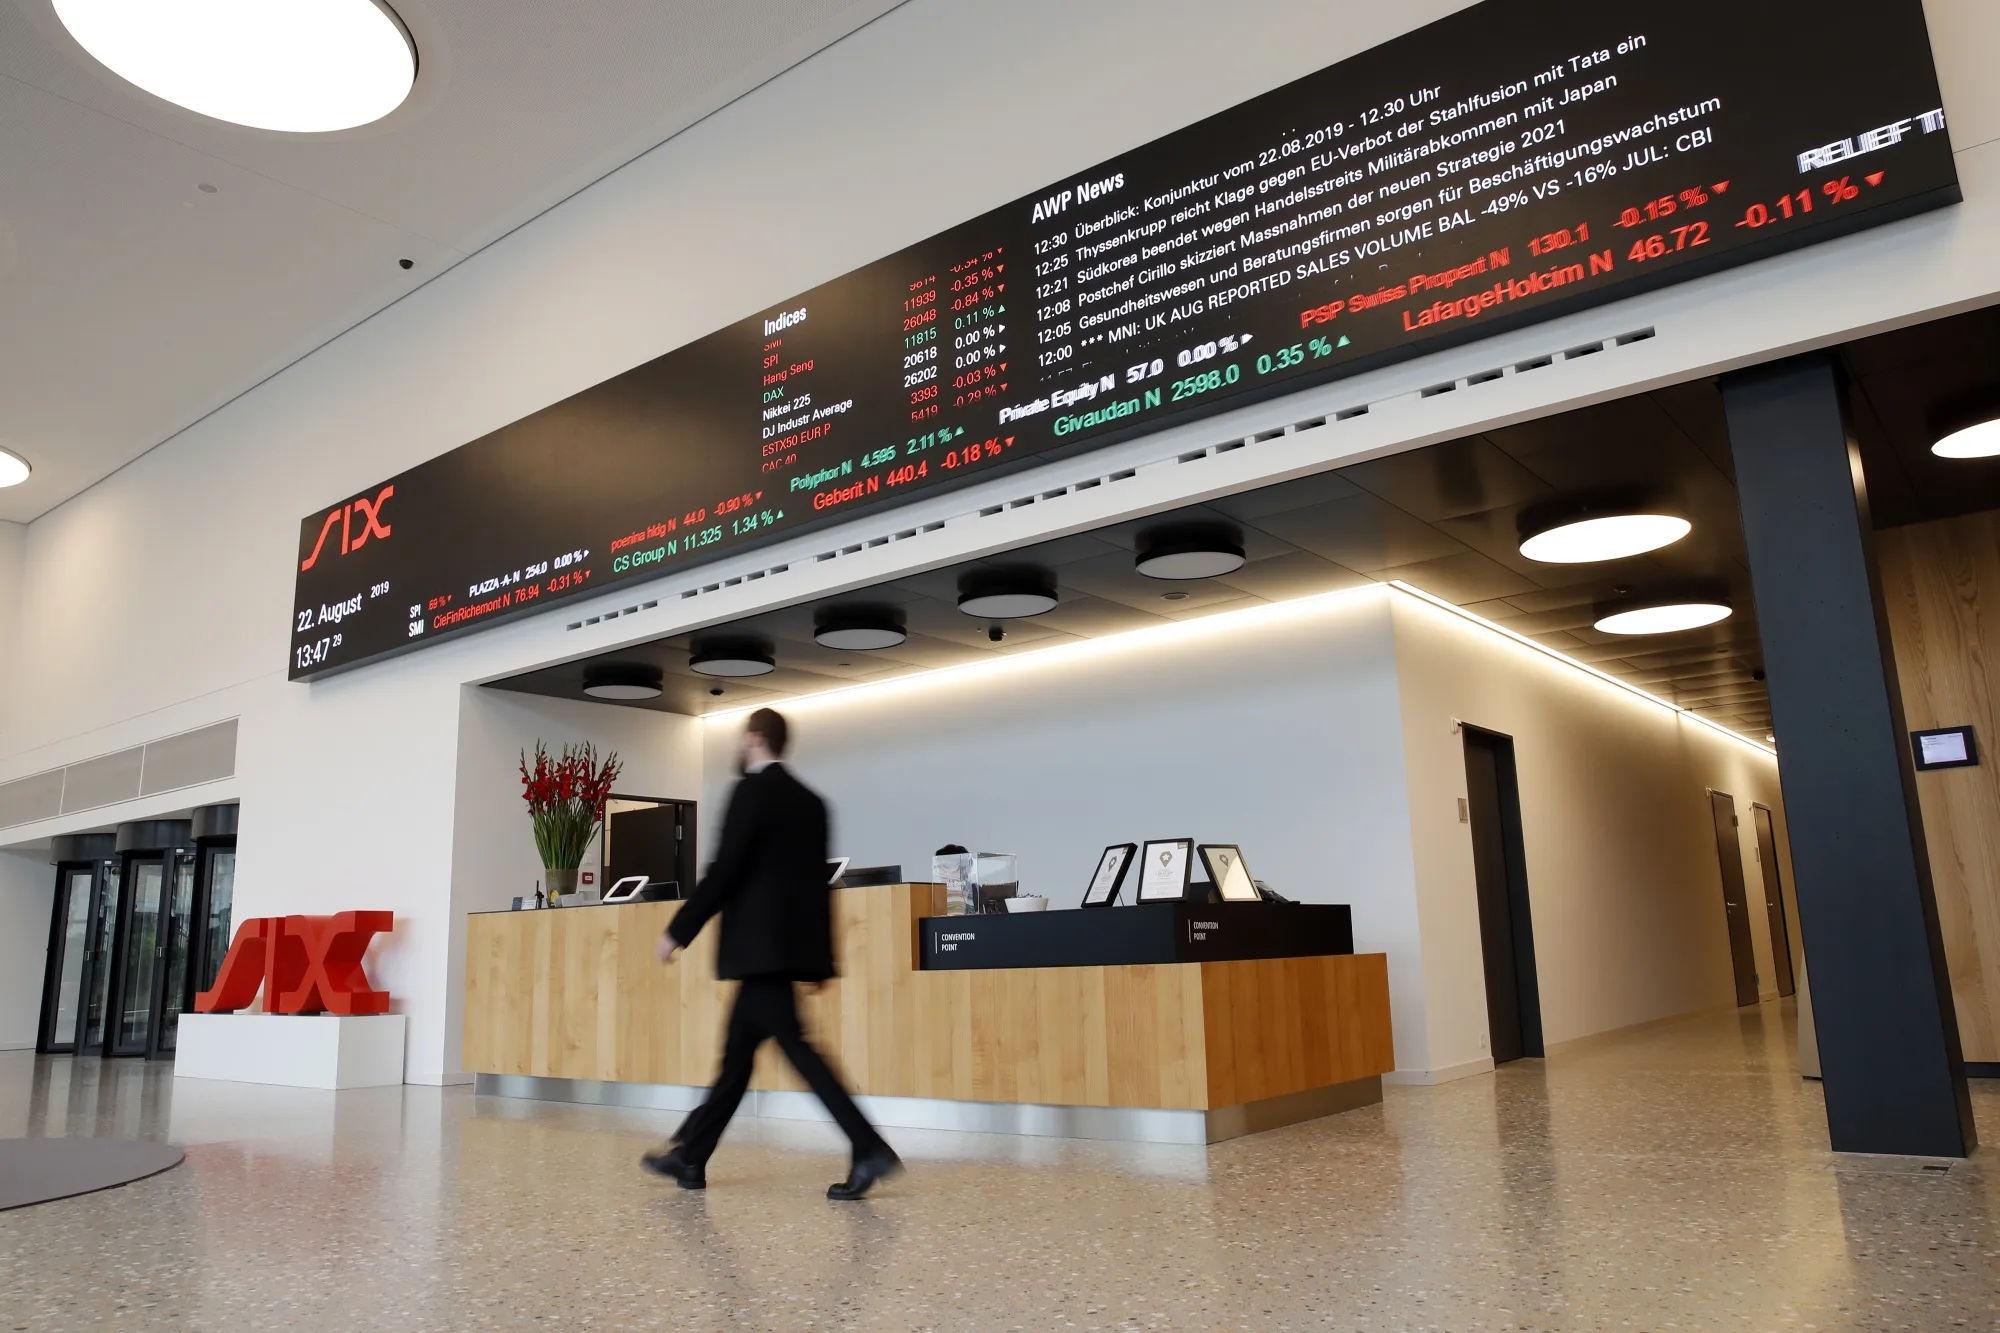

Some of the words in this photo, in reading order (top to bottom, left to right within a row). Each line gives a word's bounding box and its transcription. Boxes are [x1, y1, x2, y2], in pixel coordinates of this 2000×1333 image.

[1034, 231, 1068, 255] 12:30
[1075, 205, 1140, 239] Überblick:
[1144, 173, 1219, 212] Konjunktur
[1222, 160, 1255, 180] vom
[1258, 122, 1344, 167] 22.08.2019
[1360, 98, 1405, 126] 12.30
[1409, 86, 1441, 107] Uhr
[1035, 253, 1069, 277] 12:25
[1075, 218, 1167, 261] Thyssenkrupp
[1171, 200, 1211, 225] reicht
[1214, 185, 1255, 209] Klage
[1259, 165, 1306, 194] gegen
[1310, 130, 1393, 172] EU-Verbot
[1397, 119, 1425, 138] der
[1429, 80, 1528, 126] Stahlfusion
[1533, 64, 1565, 87] mit
[1567, 49, 1611, 73] Tata
[1616, 35, 1646, 55] ein
[1036, 276, 1068, 299] 12:21
[1077, 253, 1138, 284] Südkorea
[1141, 229, 1198, 260] beendet
[1200, 211, 1250, 237] wegen
[1254, 169, 1363, 218] Handelsstreits
[1368, 112, 1518, 176] Militärabkommen
[1523, 96, 1555, 119] mit
[1559, 75, 1617, 106] Japan
[1797, 118, 1912, 174] RELIEF
[1031, 190, 1072, 224] AWP
[1077, 173, 1125, 205] News
[1036, 298, 1071, 322] 12:08
[1078, 274, 1135, 307] Postchef
[1138, 262, 1176, 285] Cirillo
[1179, 239, 1236, 270] skizziert
[1240, 203, 1342, 249] Massnahmen
[1347, 190, 1374, 209] der
[1379, 171, 1431, 199] neuen
[1436, 140, 1516, 178] Strategie
[1520, 119, 1565, 149] 2021
[1037, 321, 1072, 344] 12:05
[1078, 277, 1205, 329] Gesundheitswesen
[1209, 262, 1238, 284] und
[1242, 219, 1371, 273] Beratungsfirmen
[1376, 198, 1433, 226] sorgen
[1438, 186, 1463, 205] für
[1469, 97, 1721, 194] Beschäftigungswachstum
[1038, 344, 1073, 367] 12:00
[1108, 322, 1141, 344] MNI:
[1145, 311, 1167, 331] UK
[1170, 299, 1204, 323] AUG
[1208, 270, 1291, 310] REPORTED
[1296, 249, 1350, 280] SALES
[1354, 221, 1433, 260] VOLUME
[1438, 209, 1476, 233] BAL
[1481, 189, 1528, 215] -49%
[1532, 179, 1560, 200] VS
[1566, 159, 1617, 187] -16%
[1622, 145, 1669, 171] JUL:
[1675, 126, 1712, 152] CBI
[1300, 299, 1345, 329] PSP
[1348, 284, 1408, 313] Swiss
[1489, 247, 1510, 270] N
[1528, 222, 1590, 257] 130.1
[1613, 194, 1677, 228] -0.15
[1402, 263, 1585, 332] LafargeHolcim
[1589, 249, 1614, 277] N
[1628, 221, 1711, 263] 46.72
[1735, 188, 1813, 228] -0.11
[1823, 175, 1859, 205] %
[763, 353, 779, 369] SPI
[904, 289, 936, 312] 11939
[950, 271, 979, 292] -0.35
[763, 369, 787, 387] Hang
[790, 359, 814, 376] Seng
[903, 308, 937, 332] 26048
[950, 291, 979, 311] -0.84
[763, 386, 784, 404] DAX
[904, 326, 937, 349] 11815
[954, 311, 978, 330] 0.11
[764, 307, 807, 337] Indices
[762, 400, 791, 422] Nikkei
[792, 393, 811, 411] 225
[903, 346, 937, 369] 20618
[954, 330, 981, 350] 0.00
[762, 424, 775, 439] DJ
[777, 414, 811, 434] Industr
[812, 399, 853, 422] Average
[904, 365, 938, 388] 26202
[955, 349, 981, 369] 0.00
[762, 434, 798, 457] ESTX50
[800, 426, 821, 444] EUR
[823, 422, 831, 436] P
[910, 384, 938, 405] 3393
[952, 369, 981, 389] -0.03
[998, 398, 1050, 425] Private
[1050, 381, 1100, 409] Equity
[1099, 372, 1116, 393] N
[1126, 358, 1164, 384] 57.0
[1176, 341, 1217, 368] 0.00
[1054, 398, 1141, 436] Givaudan
[1144, 387, 1161, 410] N
[1171, 363, 1240, 402] 2598.0
[1256, 343, 1305, 375] 0.35
[1309, 335, 1332, 359] %
[790, 466, 841, 493] Polyphor
[841, 459, 852, 476] N
[860, 444, 897, 469] 4.595
[906, 431, 935, 455] 2.11
[813, 481, 864, 510] Geberit
[866, 475, 879, 494] N
[886, 460, 929, 487] 440.4
[940, 443, 981, 469] -0.18
[984, 437, 1002, 457] %
[613, 554, 630, 573] CS
[631, 546, 666, 567] Group
[667, 539, 677, 557] N
[683, 524, 722, 551] 11.325
[732, 513, 759, 536] 1.34
[296, 608, 315, 633] 22.
[317, 592, 363, 625] August
[370, 580, 390, 599] 2019
[408, 618, 425, 638] SMI
[409, 603, 422, 619] SPI
[433, 596, 502, 629] CieFinRichemont
[502, 592, 511, 607] N
[515, 583, 540, 604] 76.94
[546, 574, 570, 592] -0.31
[296, 637, 331, 669] 13:47
[332, 633, 343, 648] 29
[941, 932, 976, 941] CONVENTION
[941, 943, 958, 951] POINT
